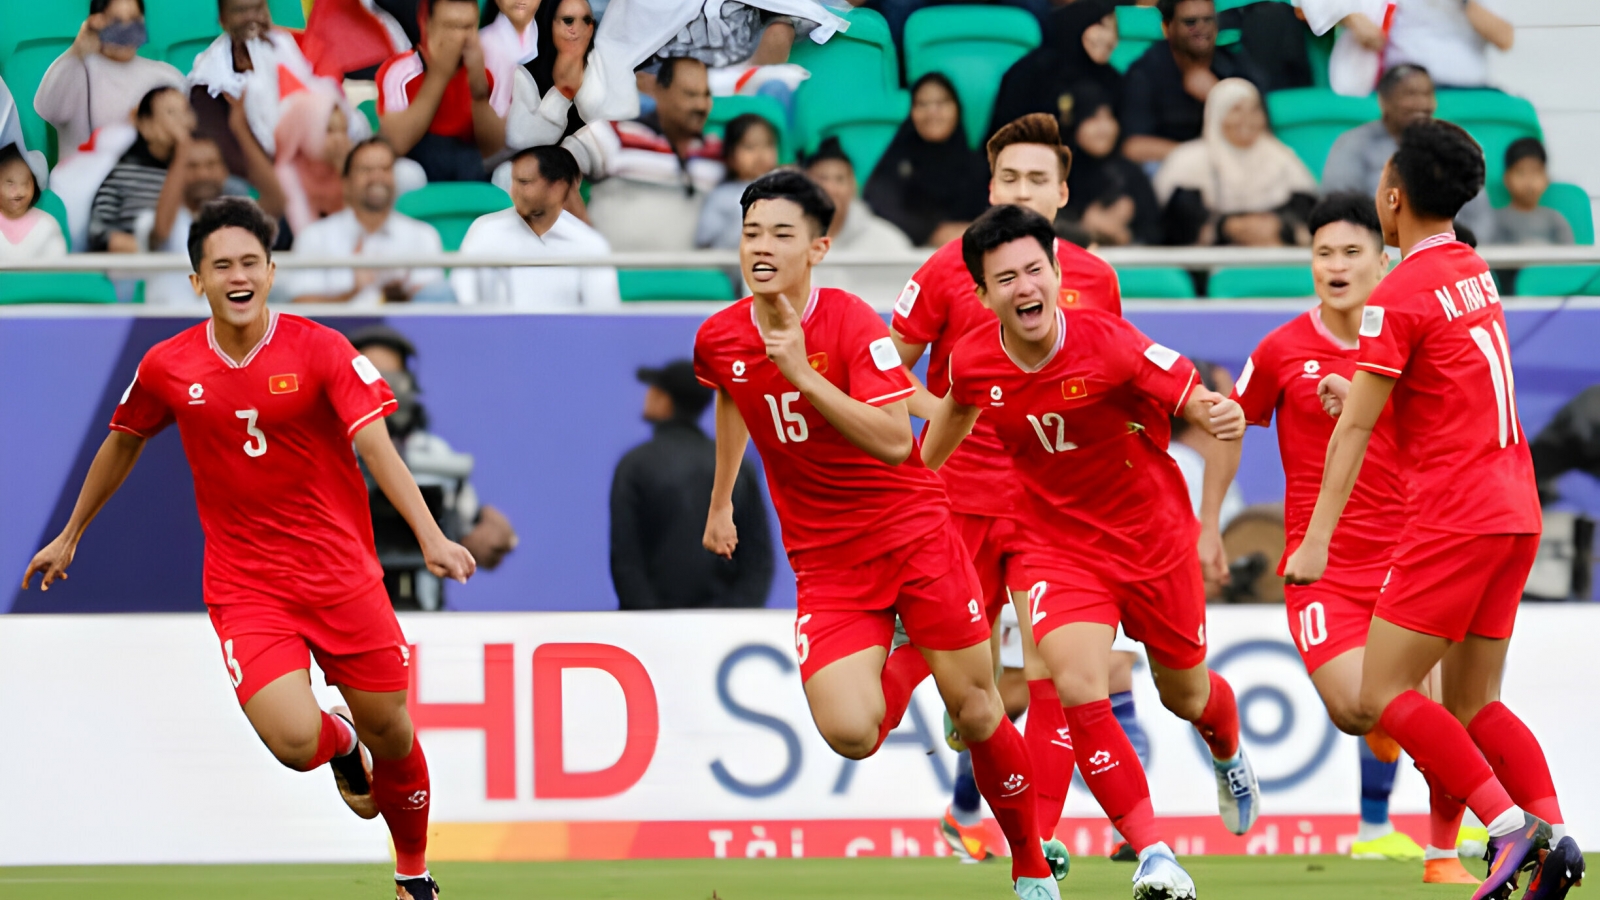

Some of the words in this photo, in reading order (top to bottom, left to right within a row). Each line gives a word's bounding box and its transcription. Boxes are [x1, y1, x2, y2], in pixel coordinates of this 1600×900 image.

[235, 408, 267, 457] 3
[764, 391, 809, 443] 15
[1026, 412, 1079, 454] 12
[1299, 601, 1328, 652] 10
[407, 643, 660, 800] HD
